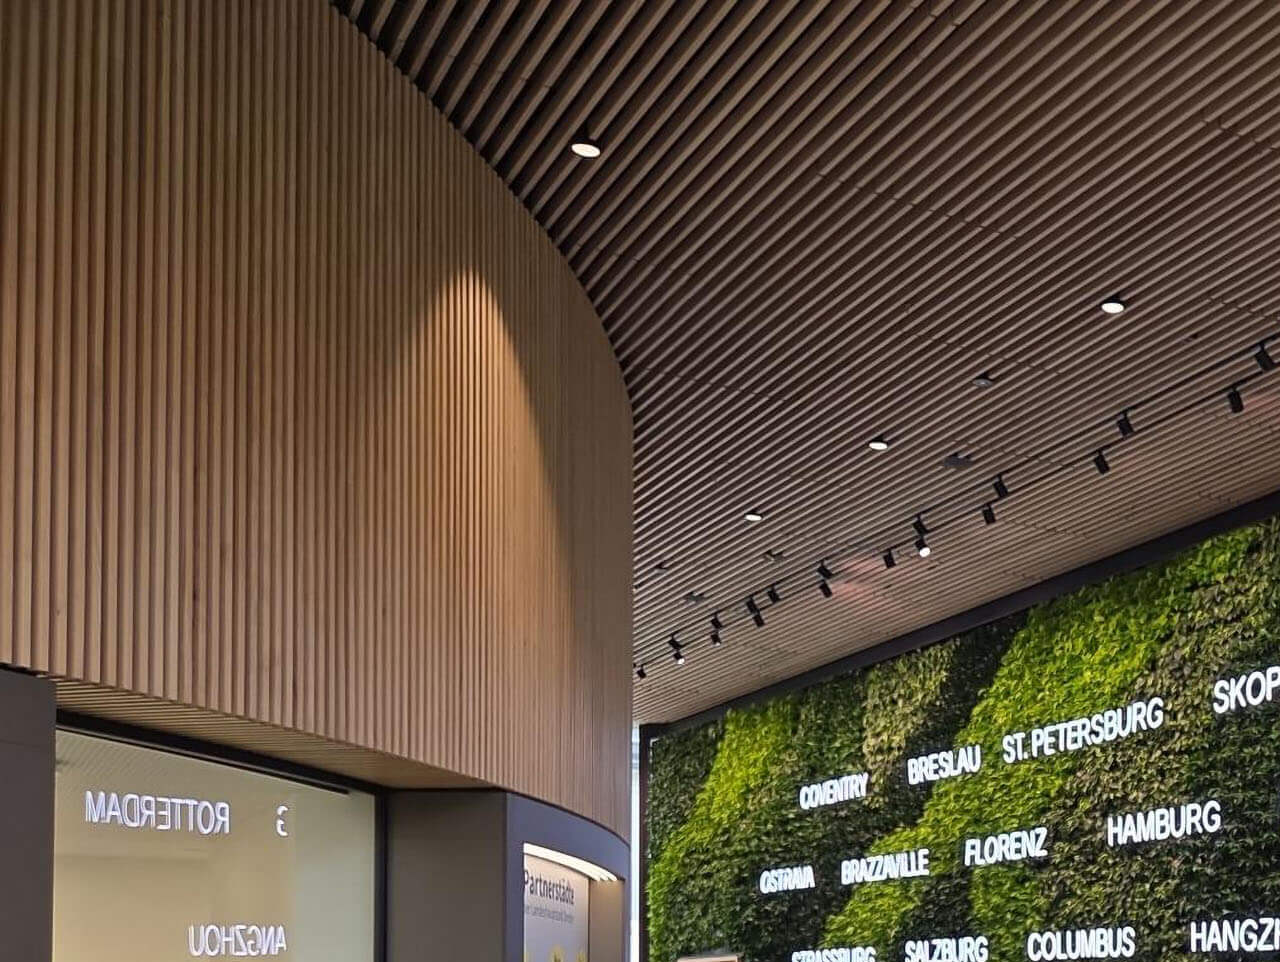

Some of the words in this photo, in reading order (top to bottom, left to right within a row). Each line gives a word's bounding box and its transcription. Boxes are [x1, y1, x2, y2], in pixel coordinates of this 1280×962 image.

[907, 745, 983, 786] BRESLAU
[800, 772, 869, 811] COVENTRY
[1107, 799, 1222, 848] HAMBURG
[964, 826, 1049, 868] FLORENZ
[759, 865, 817, 895] OSTRAVA
[841, 848, 931, 886] BRAZZAVILLE
[1027, 926, 1137, 962] COLUMBUS
